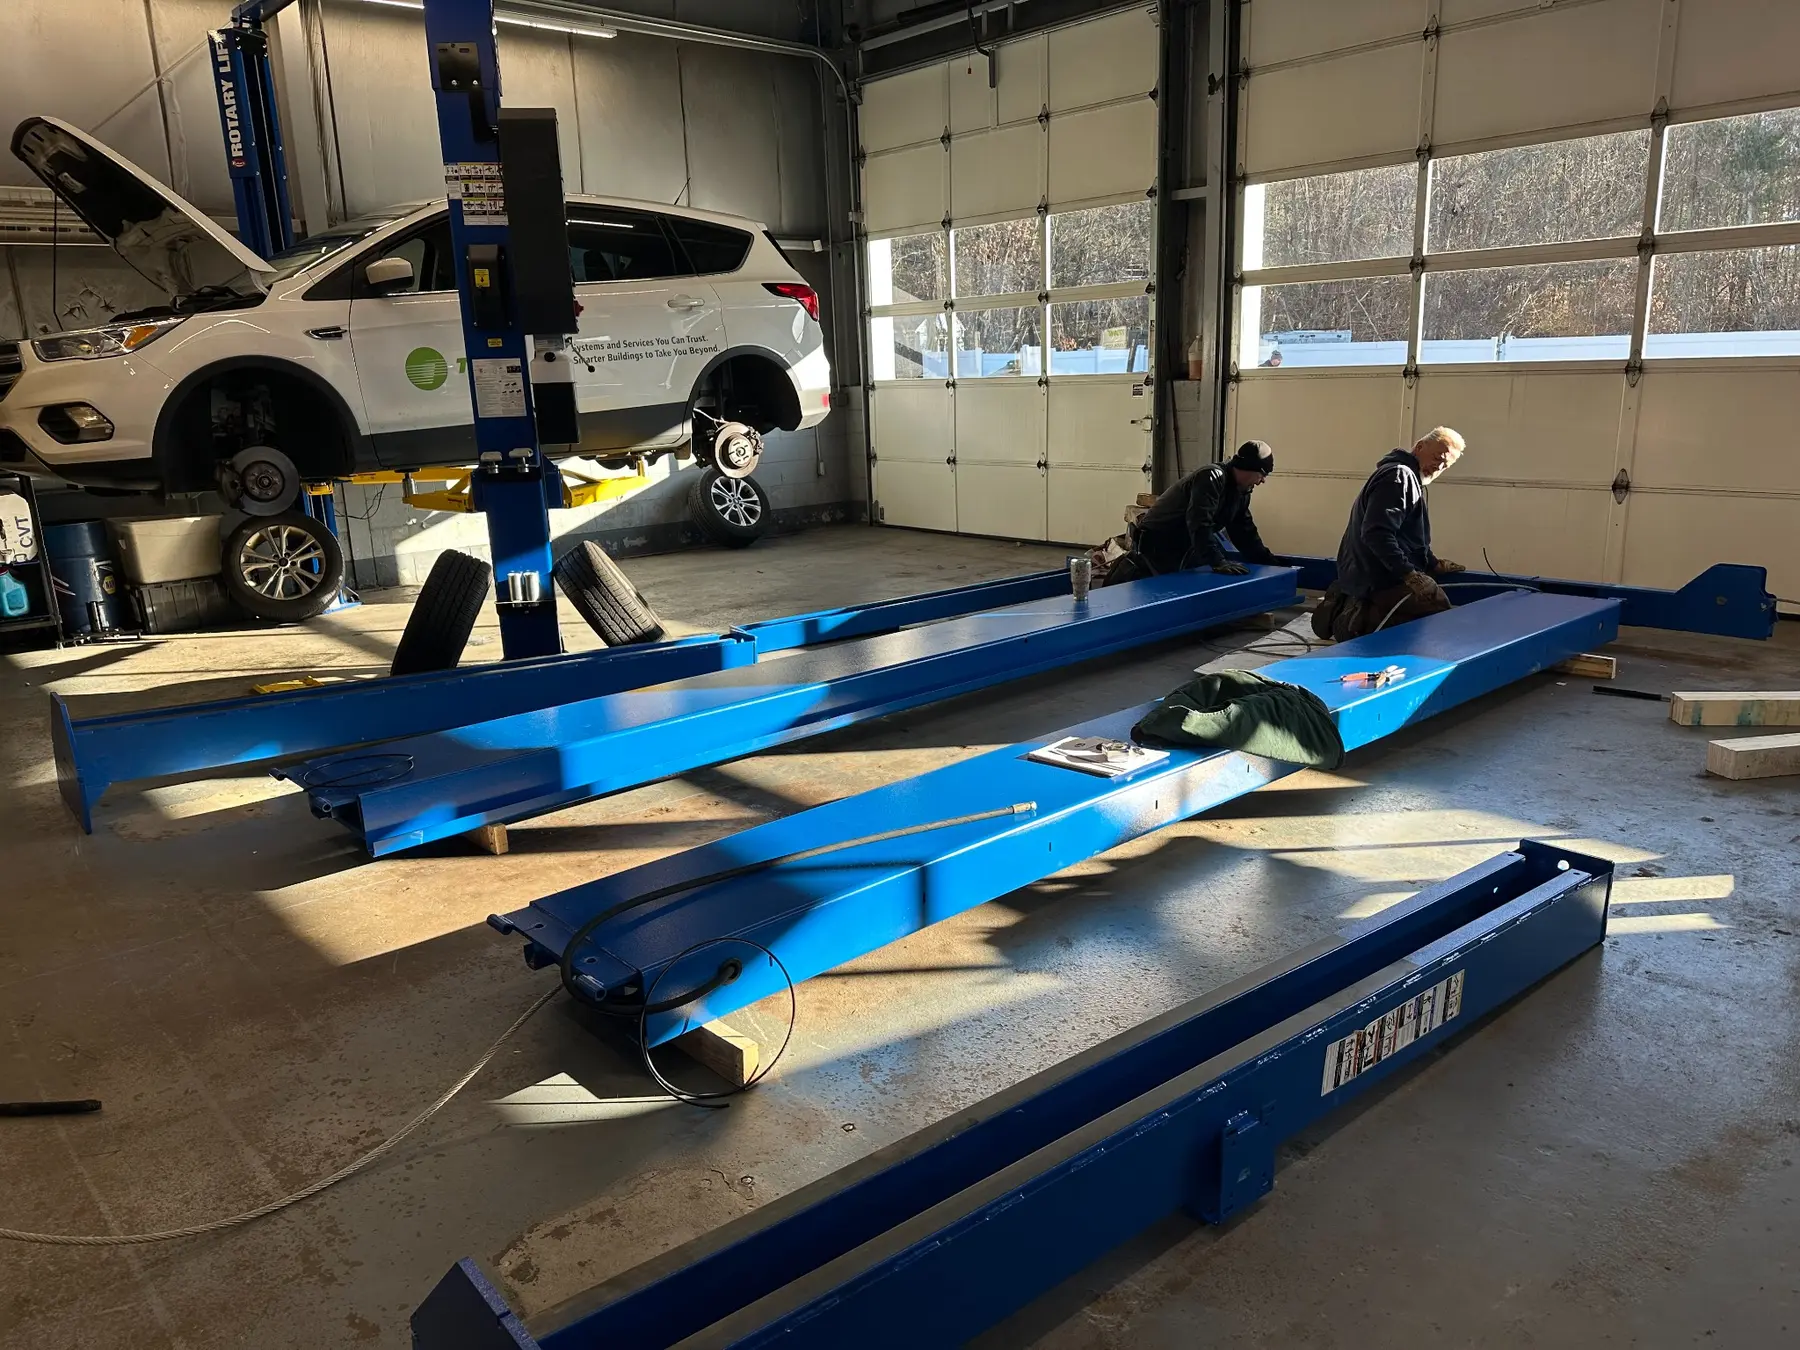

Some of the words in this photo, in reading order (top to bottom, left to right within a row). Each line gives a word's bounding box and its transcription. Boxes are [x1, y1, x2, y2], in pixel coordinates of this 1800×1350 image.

[221, 79, 244, 157] ROTARY
[606, 340, 621, 349] and
[622, 338, 654, 348] Services
[655, 337, 670, 346] You
[671, 336, 685, 345] Can
[685, 335, 709, 343] Trust.
[607, 351, 643, 362] Buildings
[645, 350, 654, 359] to
[654, 348, 672, 358] Take
[673, 348, 688, 356] You
[689, 344, 721, 355] Beyond.
[14, 516, 33, 548] CVT
